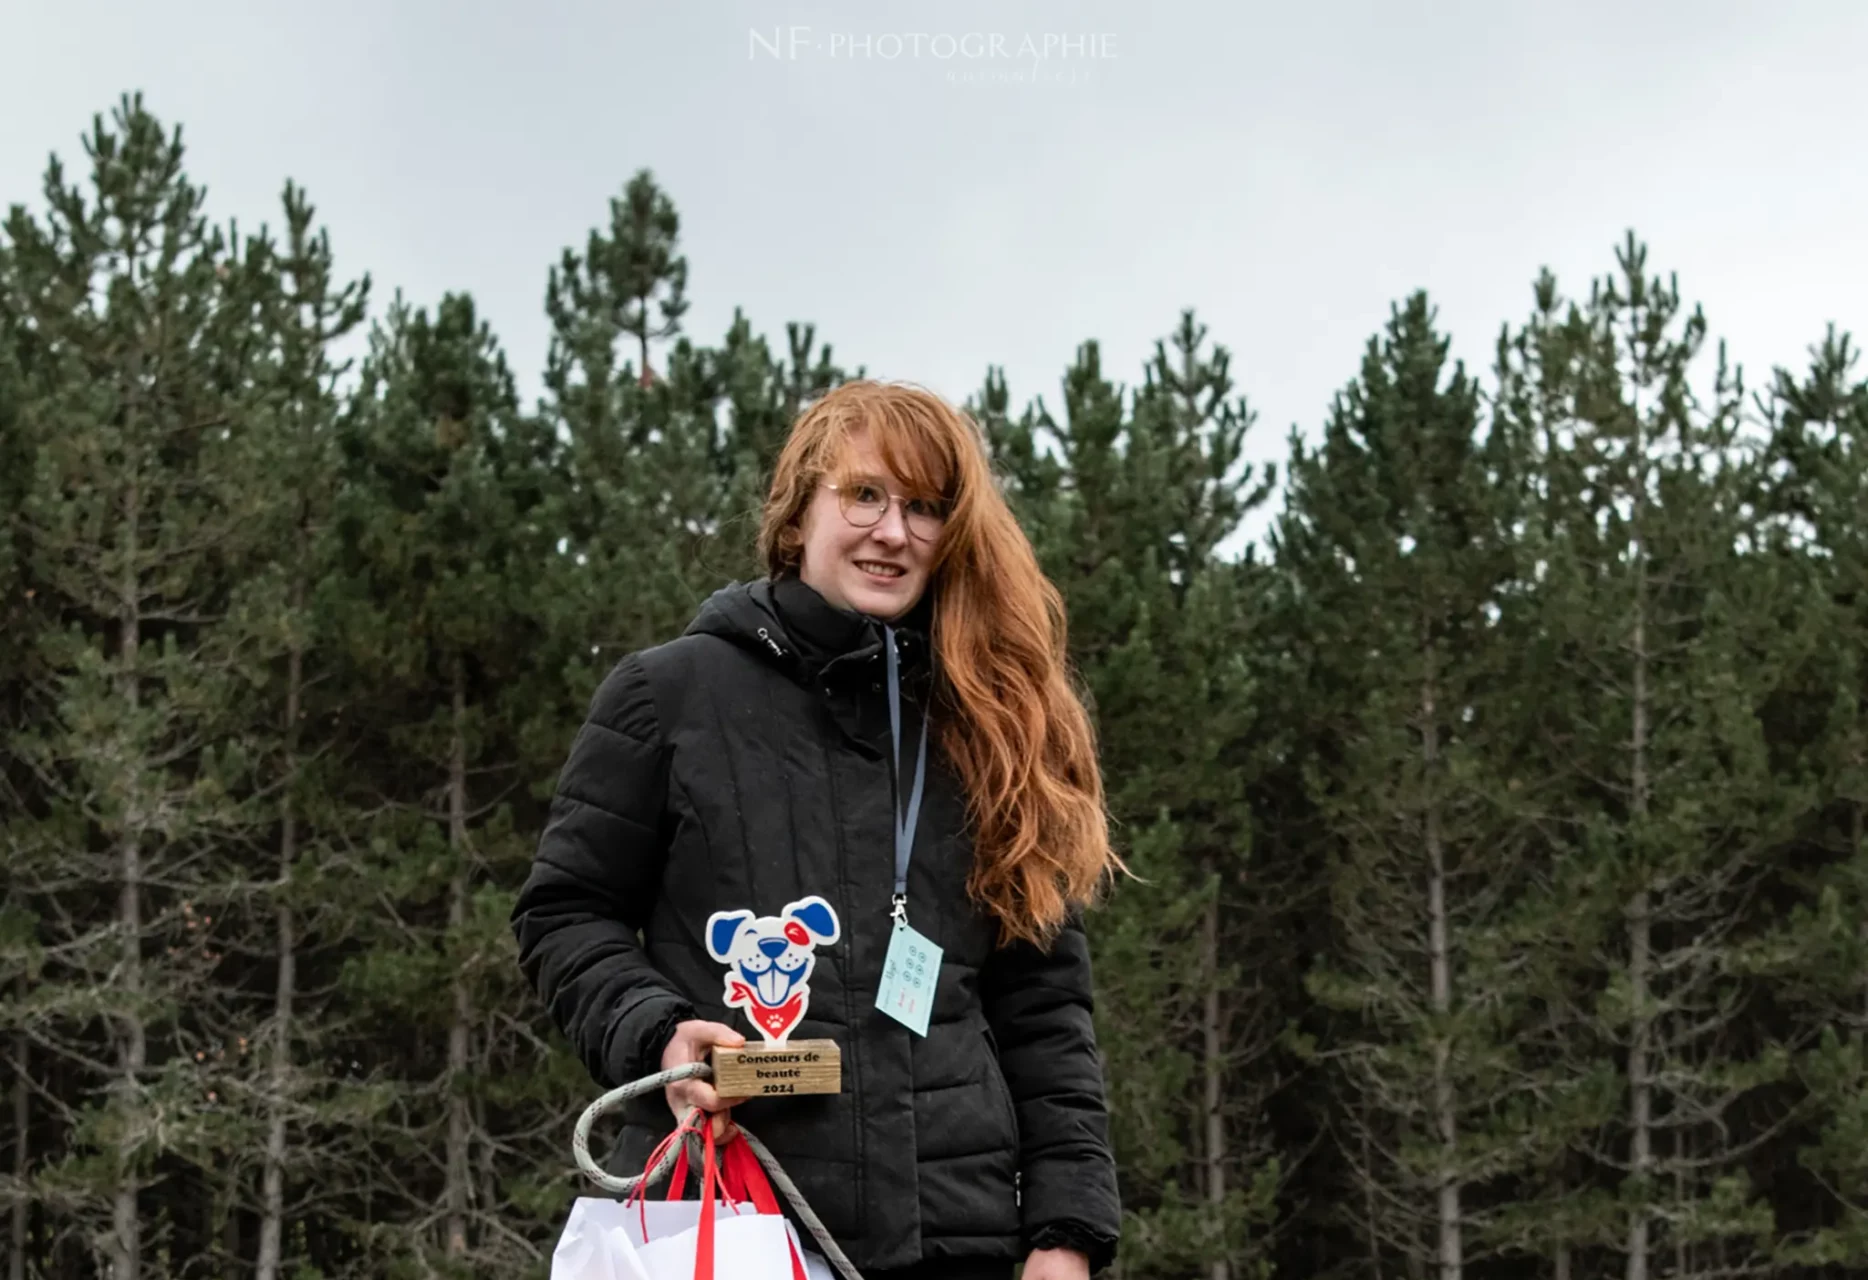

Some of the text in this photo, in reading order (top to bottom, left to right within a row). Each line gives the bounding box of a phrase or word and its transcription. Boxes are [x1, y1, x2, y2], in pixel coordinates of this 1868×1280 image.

[736, 1051, 820, 1064] Concours de
[756, 1067, 801, 1079] beauté
[763, 1084, 795, 1094] 2024
